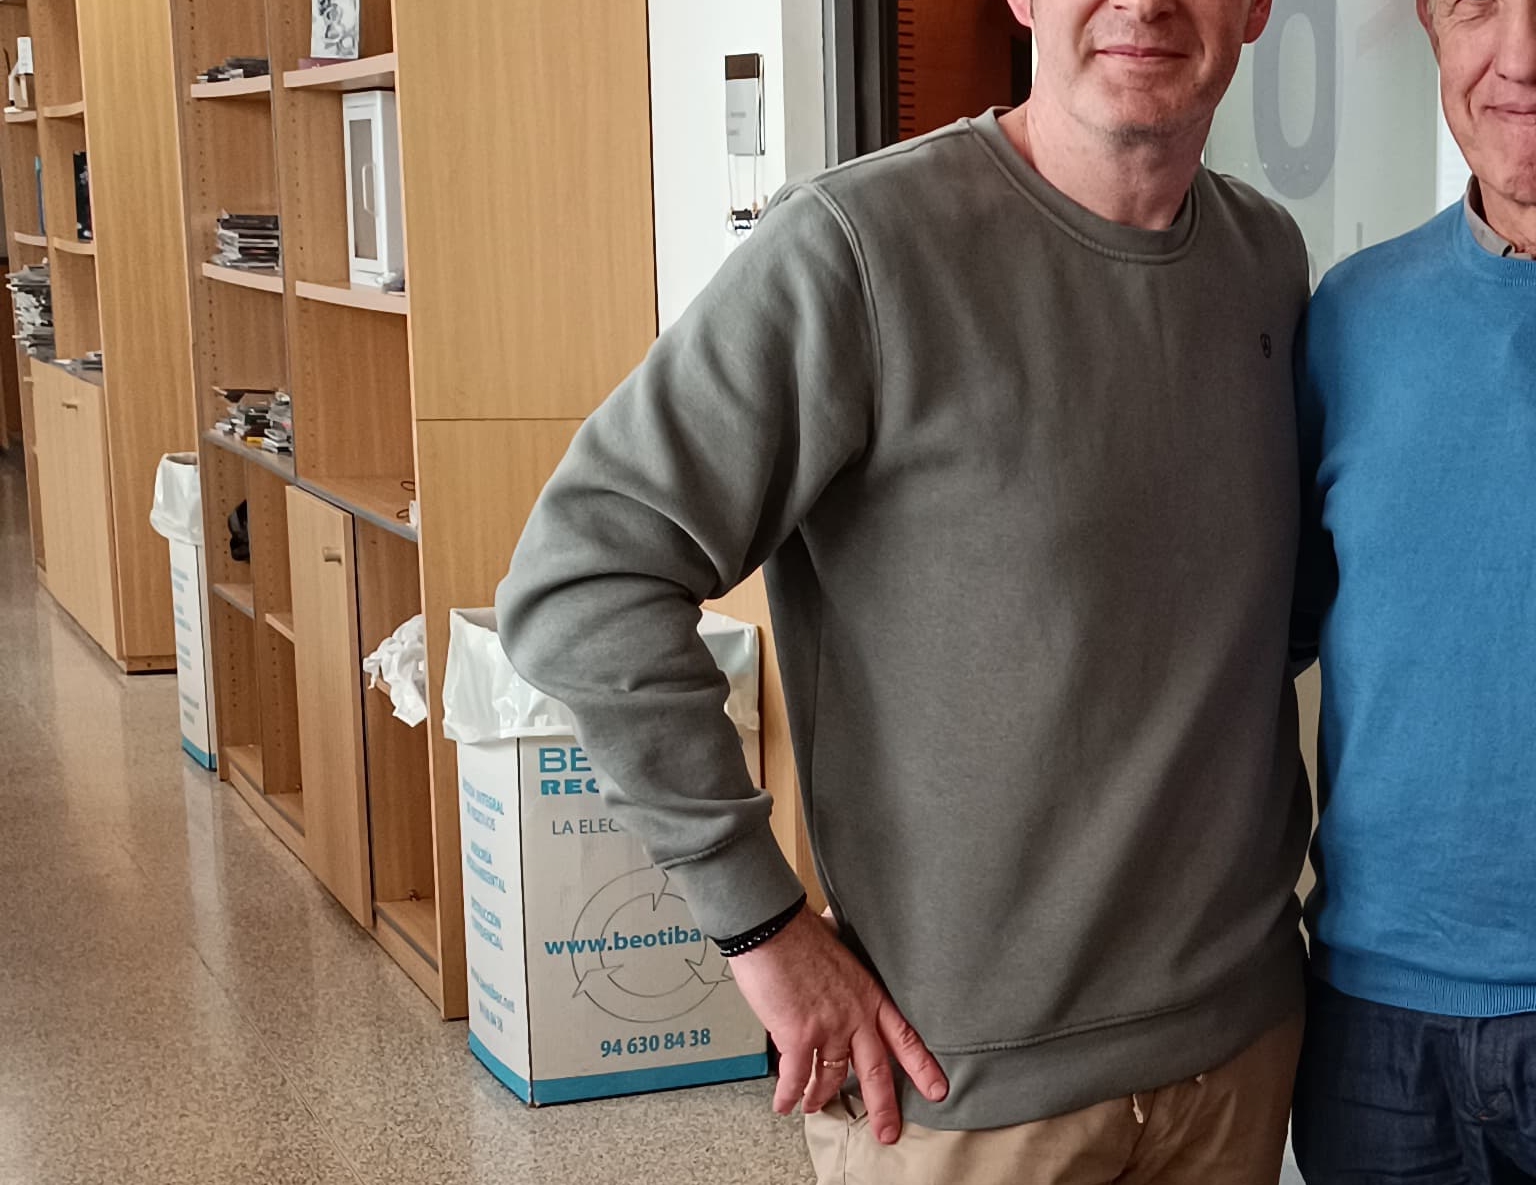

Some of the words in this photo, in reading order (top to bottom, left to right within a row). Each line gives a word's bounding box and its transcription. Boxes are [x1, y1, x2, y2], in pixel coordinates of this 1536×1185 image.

[552, 819, 574, 836] LA
[601, 1039, 623, 1058] 94
[627, 1034, 660, 1055] 630
[664, 1031, 686, 1050] 84
[690, 1028, 711, 1047] 38
